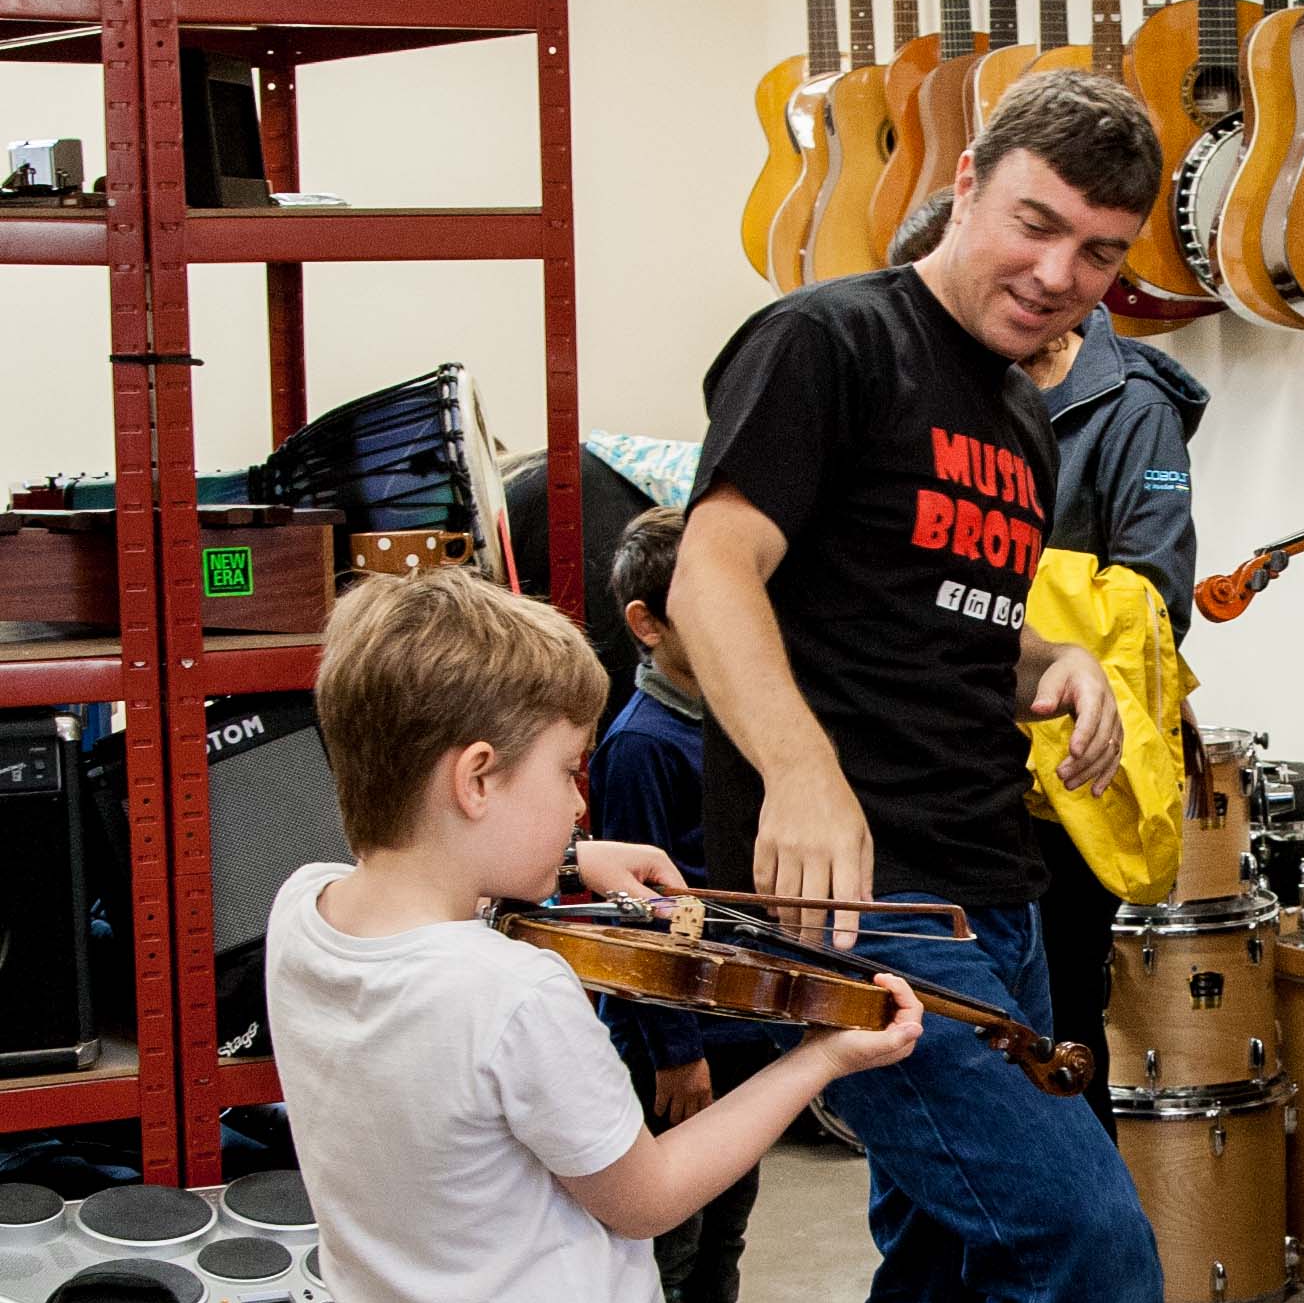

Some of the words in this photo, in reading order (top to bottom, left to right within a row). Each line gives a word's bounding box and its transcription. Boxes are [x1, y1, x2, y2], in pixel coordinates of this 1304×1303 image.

[210, 552, 246, 570] NEW
[213, 569, 246, 586] ERA
[206, 714, 265, 754] TOM
